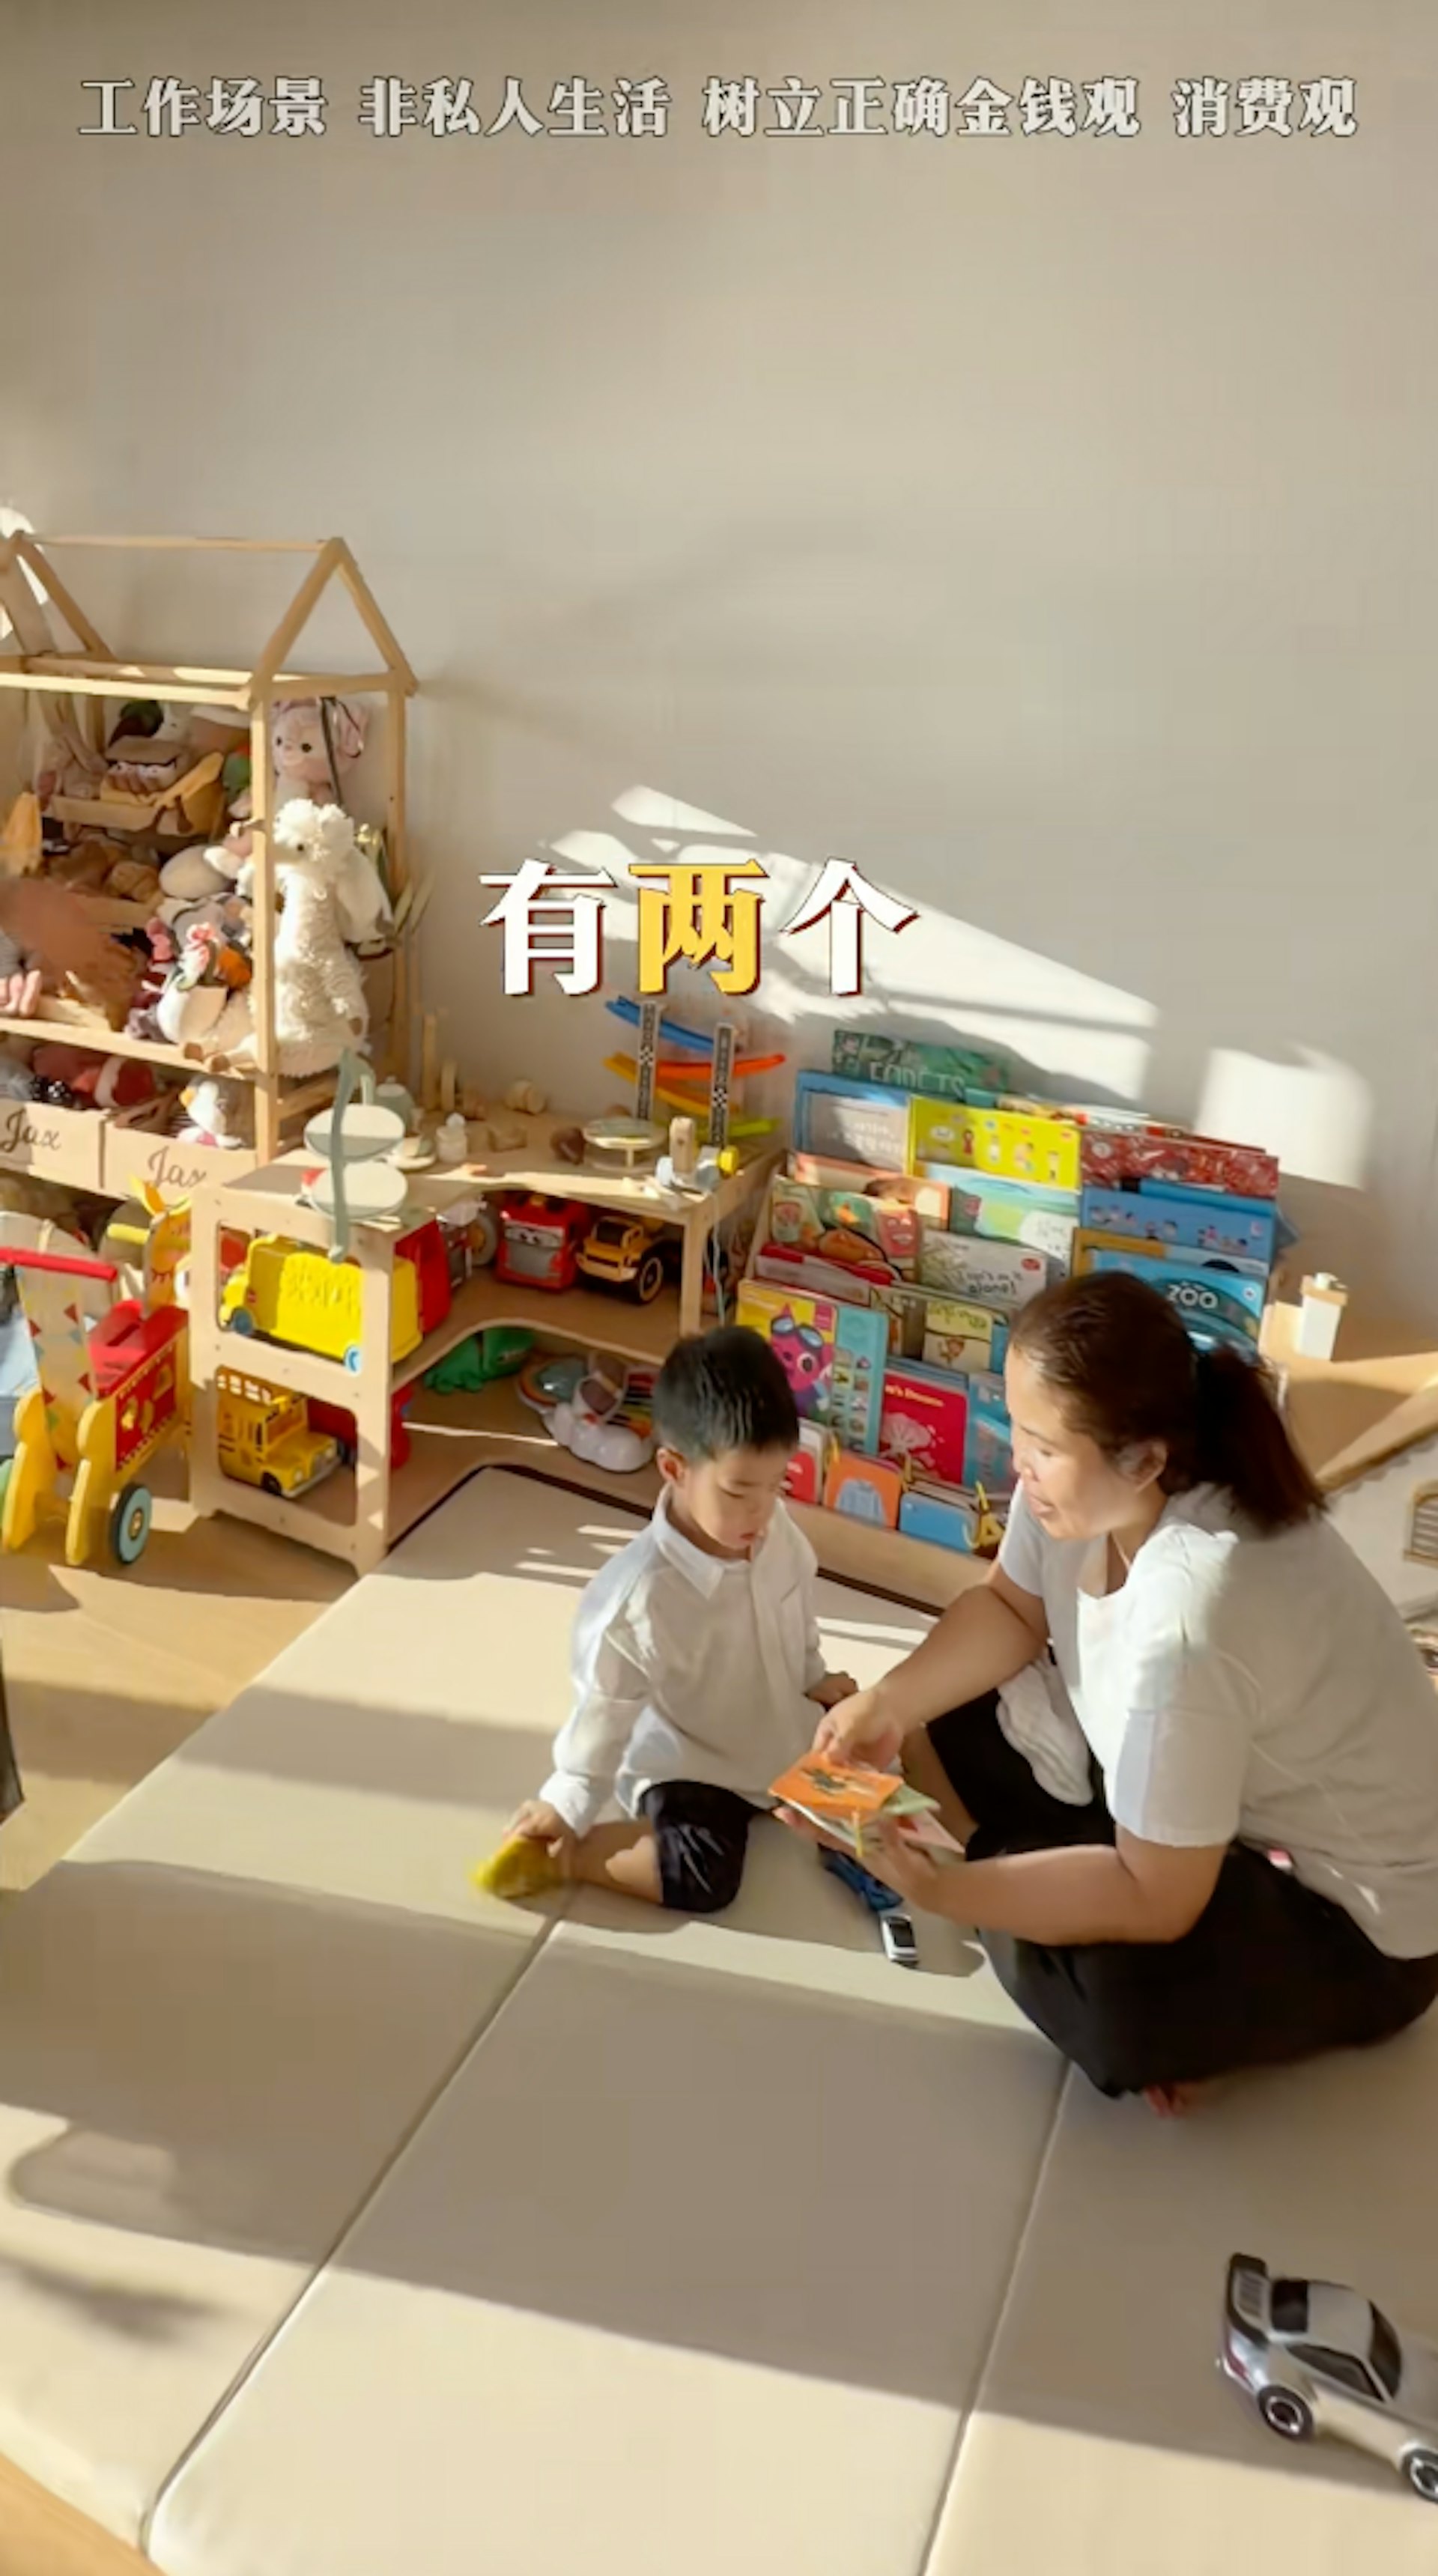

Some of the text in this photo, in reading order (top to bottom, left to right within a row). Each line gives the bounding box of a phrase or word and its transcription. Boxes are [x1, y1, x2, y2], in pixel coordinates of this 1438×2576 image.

[1, 1108, 61, 1153] Jax
[148, 1146, 207, 1188] Jax
[1167, 1284, 1219, 1310] ZOO
